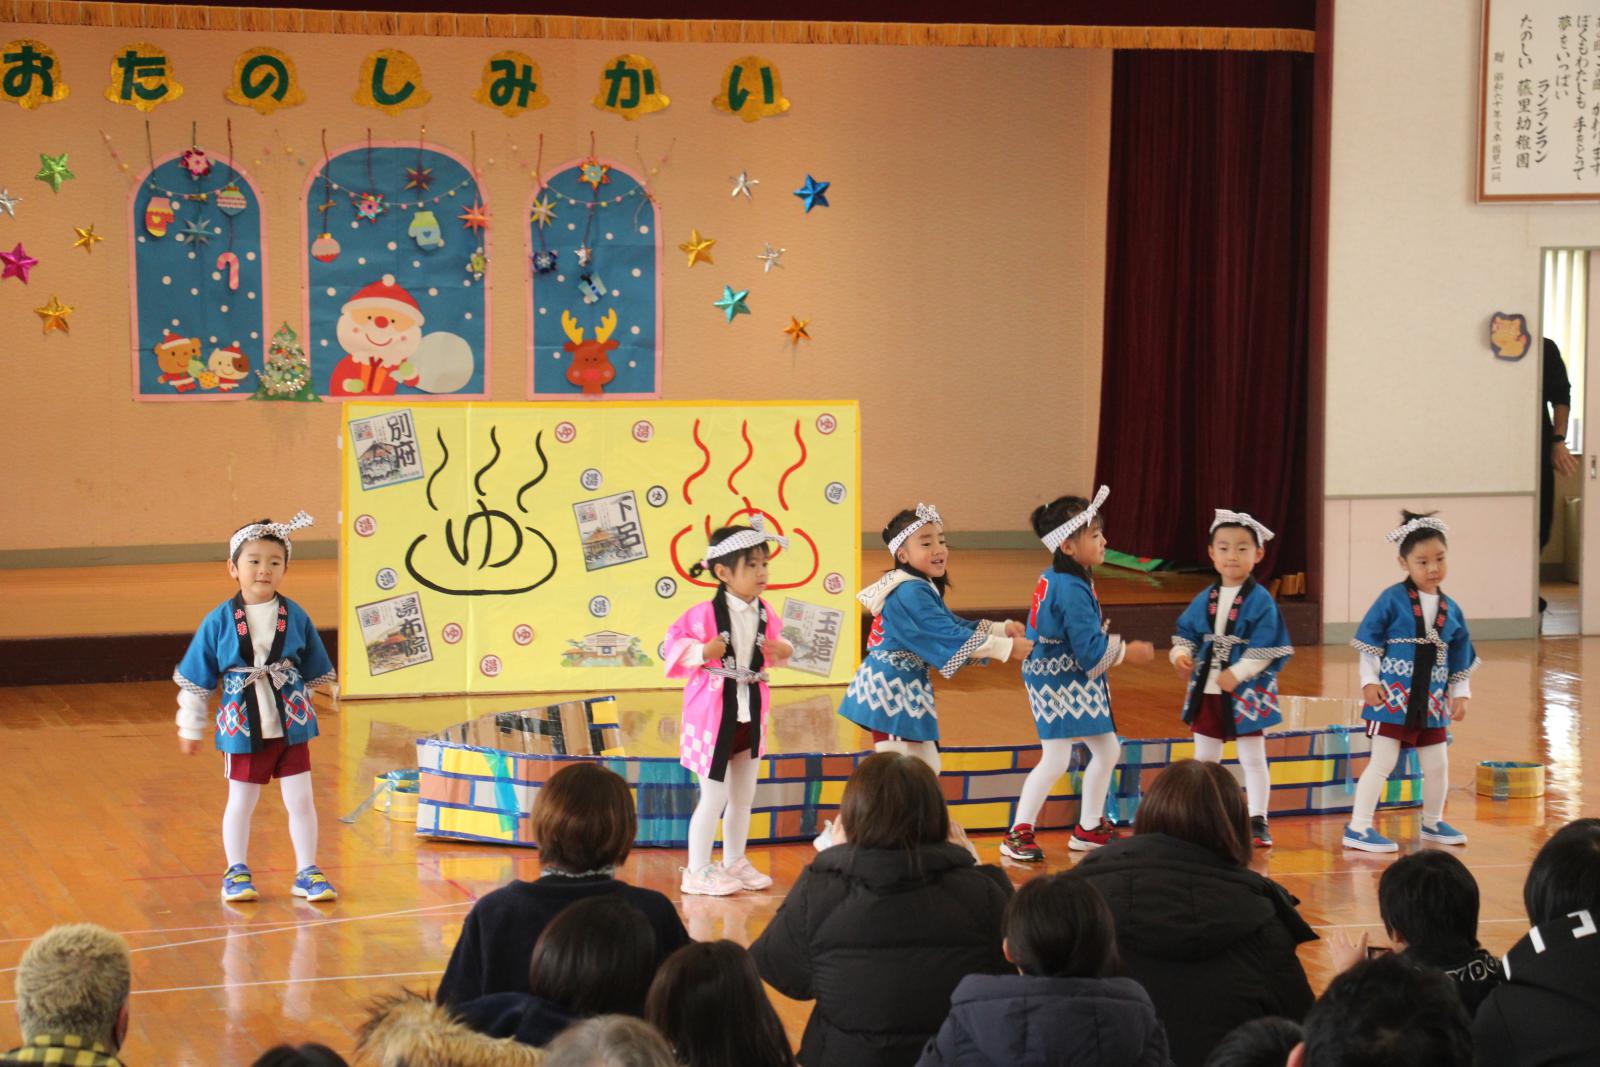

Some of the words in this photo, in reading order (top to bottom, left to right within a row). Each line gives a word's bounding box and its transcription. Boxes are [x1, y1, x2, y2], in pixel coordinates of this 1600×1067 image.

[1518, 14, 1533, 69] たのしい
[3, 45, 775, 111] おたのしみかい
[1535, 79, 1551, 164] ランランラン
[386, 413, 416, 468] 別府
[610, 495, 641, 549] 下呂
[394, 597, 427, 657] 湯布院
